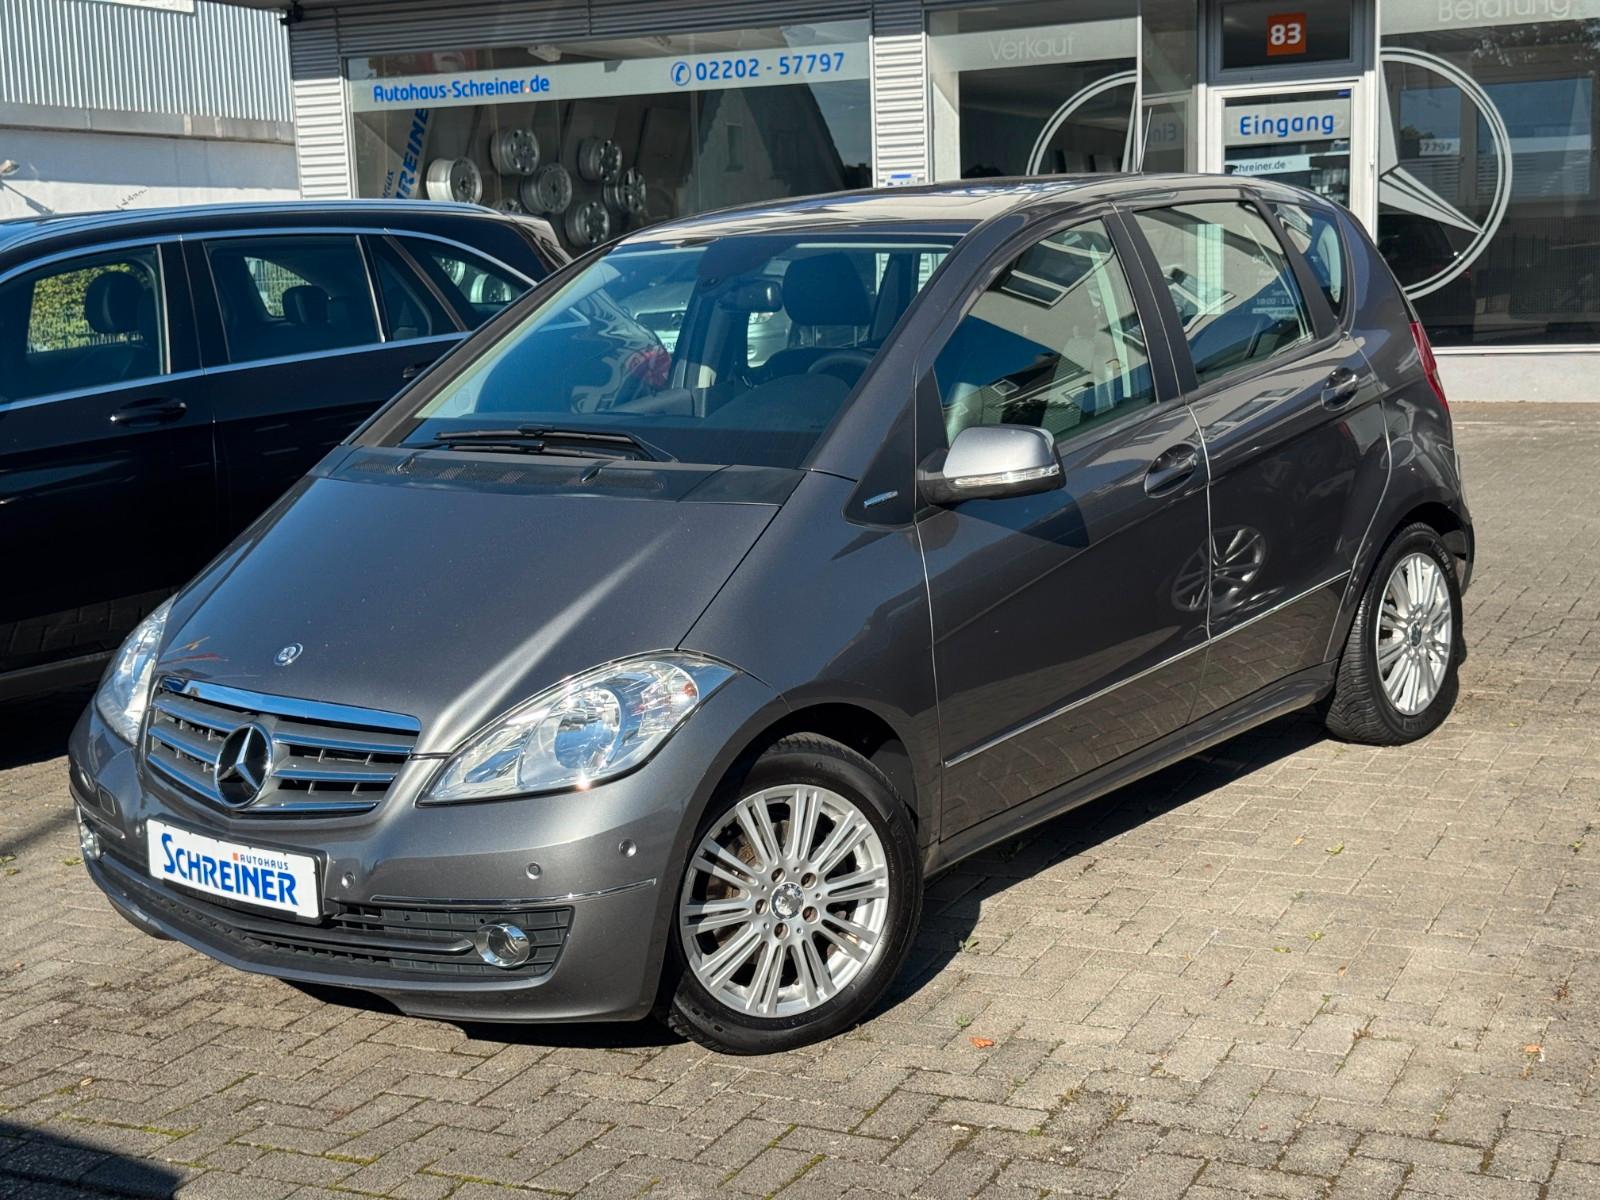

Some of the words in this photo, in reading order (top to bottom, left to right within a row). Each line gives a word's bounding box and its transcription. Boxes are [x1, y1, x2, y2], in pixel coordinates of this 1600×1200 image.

[988, 31, 1075, 61] Verkauf
[1270, 23, 1301, 46] 83
[695, 58, 760, 81] 02202
[779, 52, 845, 75] 57797
[373, 75, 550, 102] Autohaus-Schreiner.de
[1240, 114, 1335, 138] Eingang
[1233, 160, 1287, 174] chreiner.de
[161, 832, 299, 906] SCHREINER
[240, 853, 289, 871] AUTOHAUS
